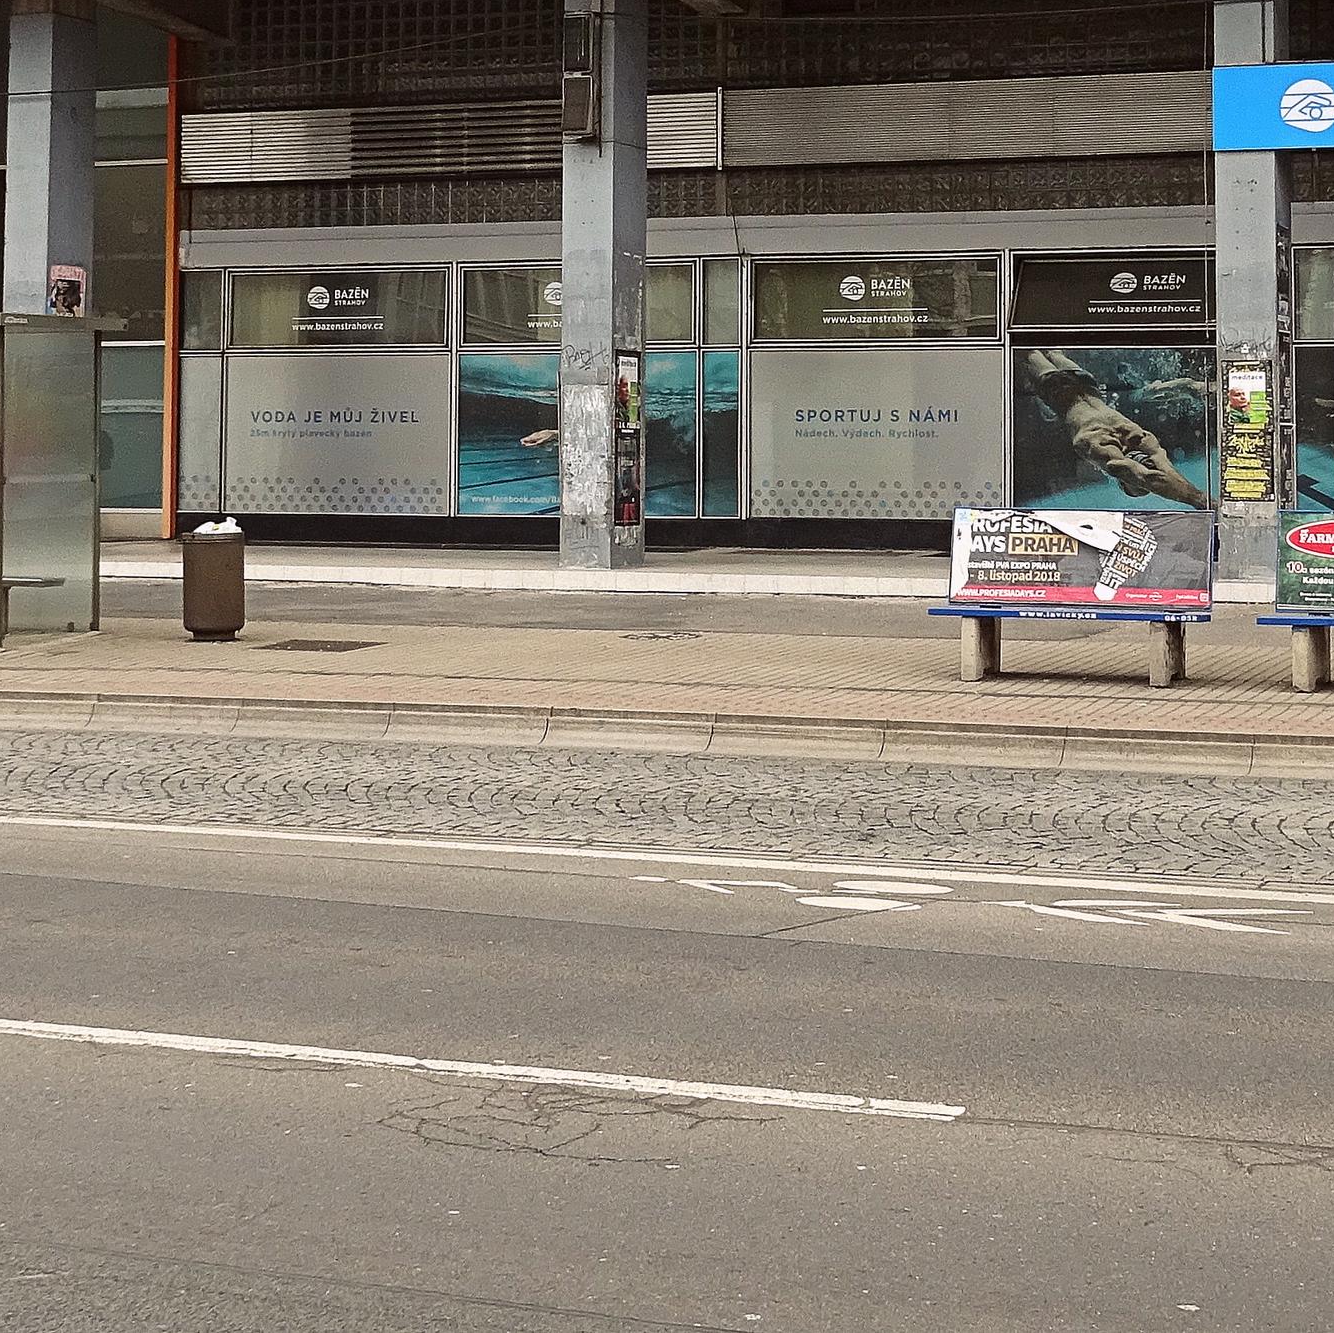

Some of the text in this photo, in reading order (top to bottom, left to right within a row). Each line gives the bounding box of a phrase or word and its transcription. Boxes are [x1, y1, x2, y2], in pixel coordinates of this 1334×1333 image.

[871, 289, 907, 297] STRAHOV
[1087, 303, 1202, 315] www.bazenstrahov.cz
[822, 312, 929, 325] www.bazenstrahov.cz
[291, 321, 385, 332] www.bazenstrahov.cz
[251, 406, 419, 423] VODA JE MŮJ ŽIVEL
[795, 405, 958, 423] SPORTUJ S NÁMI
[795, 427, 838, 438] Nádech.
[888, 427, 939, 439] Rychlost.
[970, 516, 1053, 534] ROFESIA
[970, 535, 1076, 553] AYS PRAHA
[1032, 562, 1058, 570] PRAHA
[977, 569, 988, 581] 8.
[989, 569, 1033, 583] listopad
[1033, 570, 1061, 582] 2018
[1018, 610, 1097, 620] www.lavicky.cz
